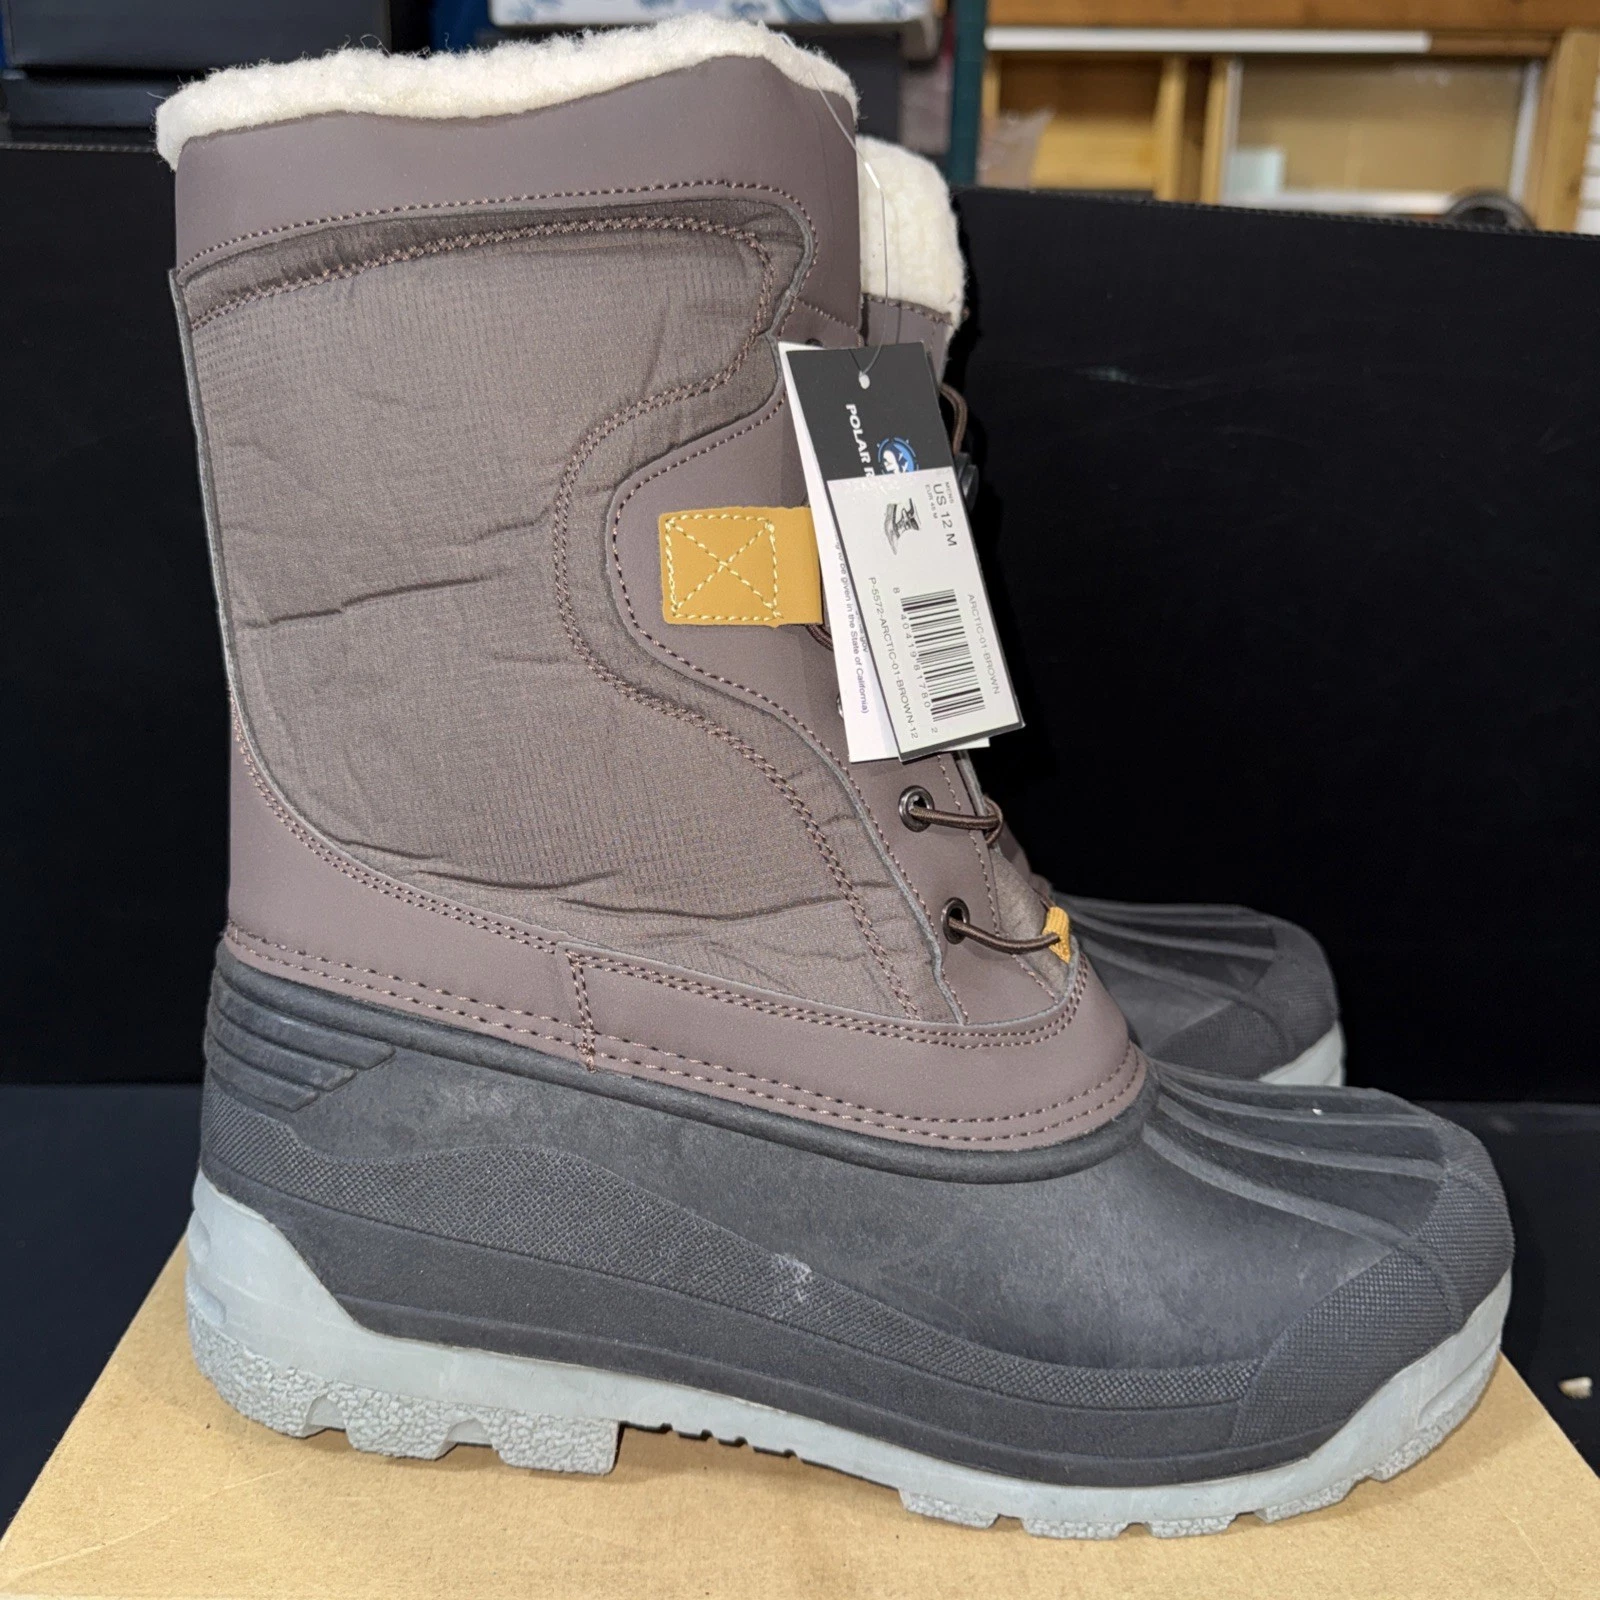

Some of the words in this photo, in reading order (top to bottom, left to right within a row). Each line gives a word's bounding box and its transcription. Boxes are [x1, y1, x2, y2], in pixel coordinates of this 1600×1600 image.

[846, 403, 871, 464] POLAR
[933, 483, 947, 506] US
[945, 481, 954, 504] MENS
[941, 511, 953, 528] 12
[946, 533, 958, 546] M
[840, 577, 852, 601] given
[846, 604, 853, 612] in
[848, 614, 857, 628] the
[850, 631, 861, 654] State
[968, 594, 1000, 695] ARCTIC-01-BROWN
[854, 657, 862, 666] of
[868, 577, 919, 739] P-5572-ARCTIC-01-BROWN-12
[901, 613, 918, 658] 40419
[913, 664, 931, 708] 81780
[856, 668, 870, 714] California)
